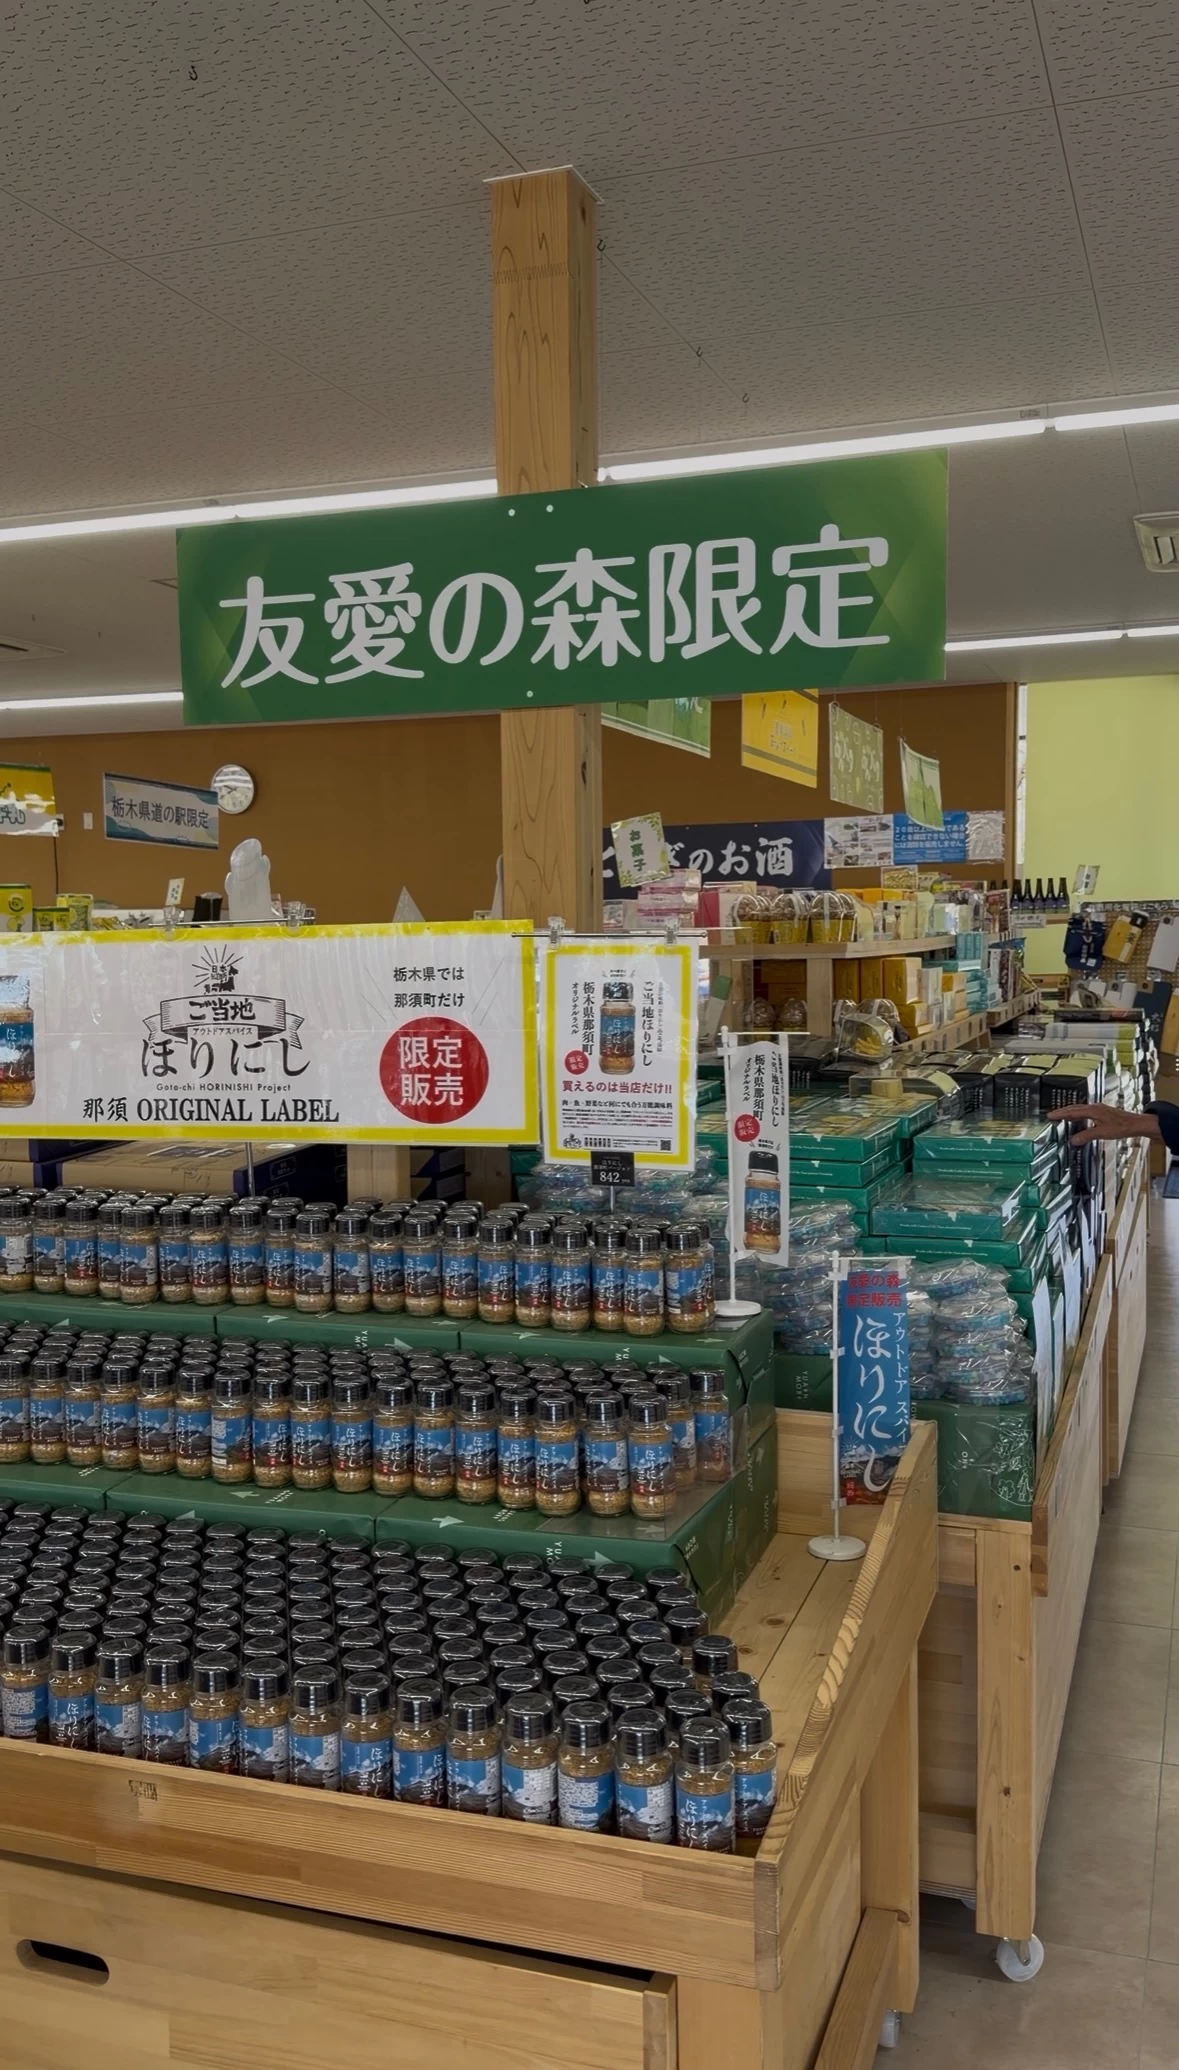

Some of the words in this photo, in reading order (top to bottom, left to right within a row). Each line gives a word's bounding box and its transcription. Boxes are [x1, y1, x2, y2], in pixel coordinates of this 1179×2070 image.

[219, 524, 890, 688] 友愛の森限定
[111, 796, 210, 829] 栃木県道の駅限定
[629, 829, 647, 872] お菓子
[393, 966, 465, 982] 栃木県では
[189, 997, 256, 1022] ご当地
[394, 992, 465, 1008] 那須町だけ
[571, 982, 580, 1035] オリジナルラベル
[582, 981, 595, 1056] 栃木県那須町
[641, 981, 655, 1067] ご当地ほりにし
[142, 1037, 311, 1078] ほりにし
[399, 1035, 463, 1069] 限定
[156, 1083, 196, 1092] Goto-chi
[200, 1083, 253, 1092] HORINISHI
[257, 1083, 291, 1094] Project
[400, 1072, 464, 1106] 販売
[562, 1080, 672, 1094] 買えるのは当店だけ!!
[82, 1097, 129, 1123] 那須
[137, 1098, 252, 1122] ORIGINAL
[261, 1098, 339, 1122] LABEL
[600, 1171, 620, 1183] 842
[848, 1273, 900, 1289] 友愛の森
[846, 1293, 901, 1308] 限定販売
[892, 1312, 908, 1394] アウトドア
[853, 1314, 892, 1492] ほりにし
[893, 1401, 910, 1450] スパイ
